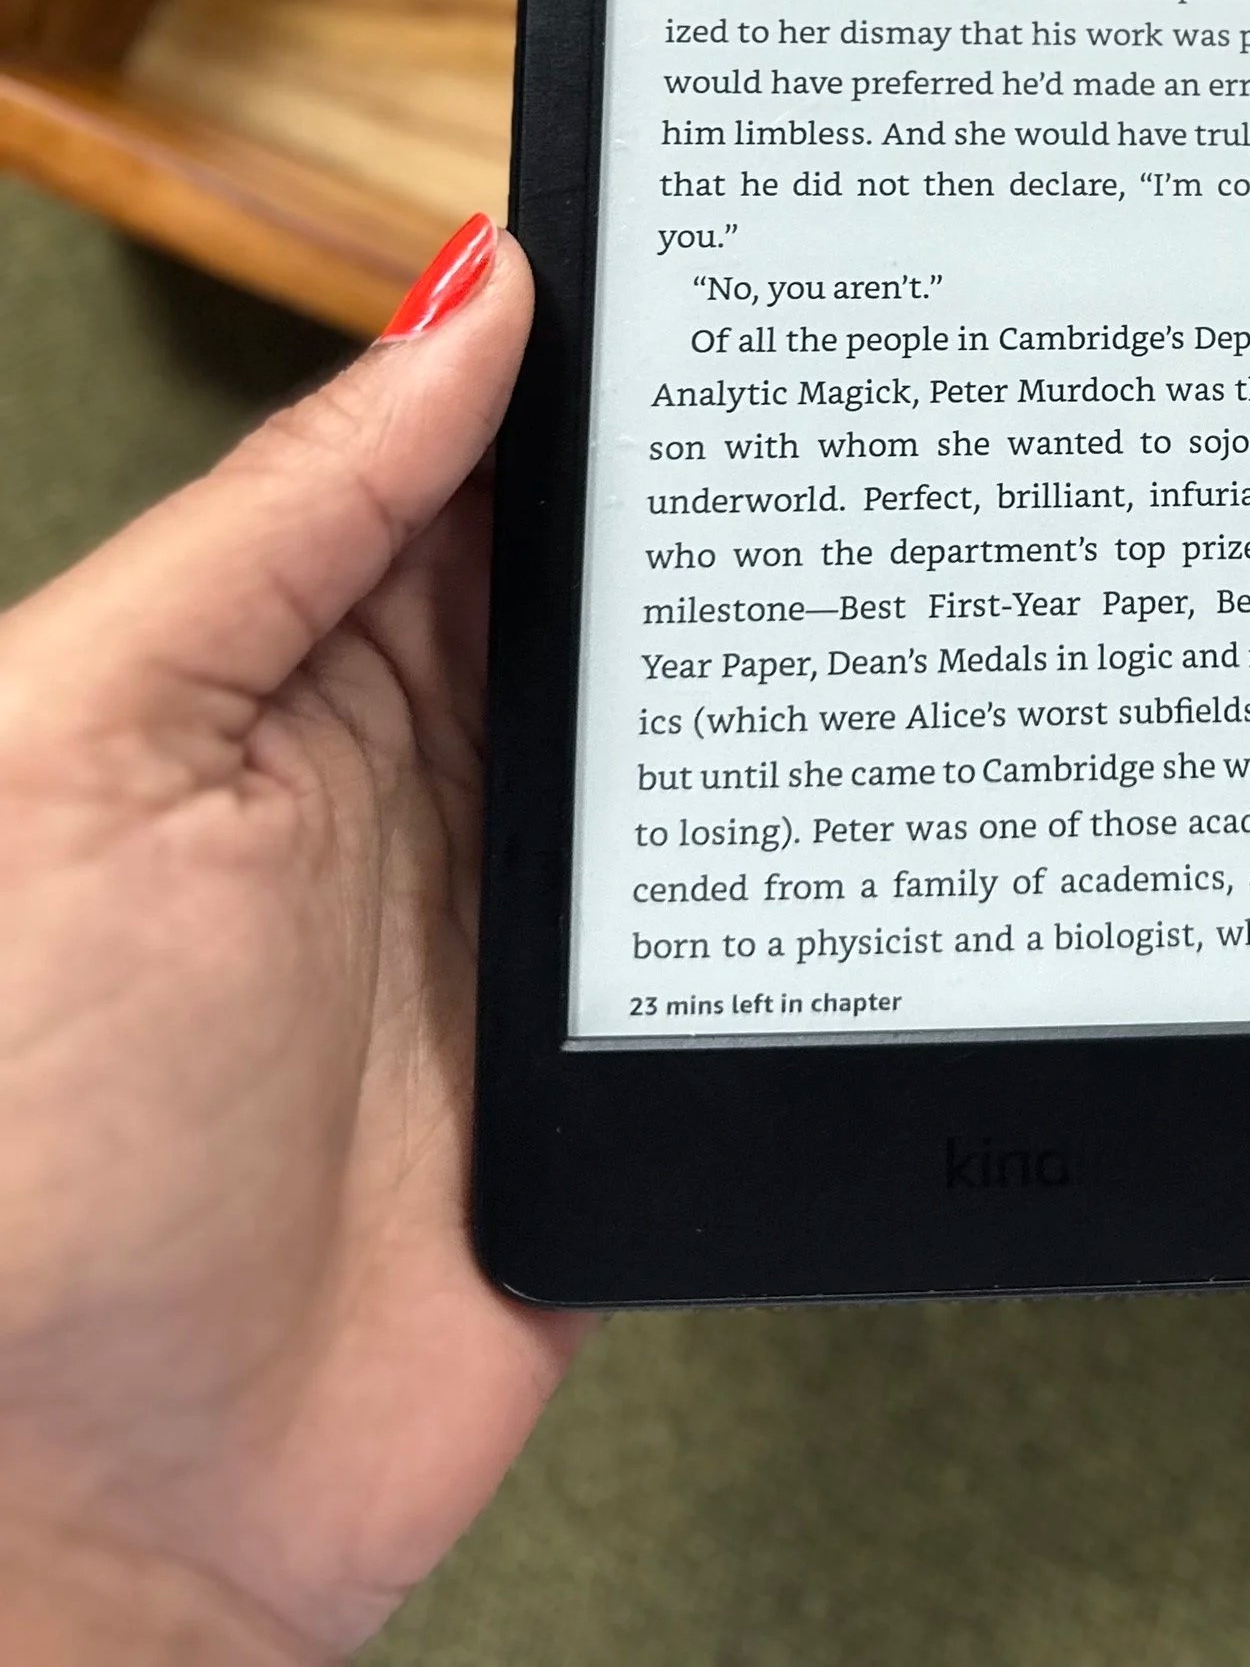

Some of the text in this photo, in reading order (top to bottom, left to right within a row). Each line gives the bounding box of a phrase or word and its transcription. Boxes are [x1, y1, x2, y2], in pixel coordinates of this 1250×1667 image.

[664, 17, 730, 44] ized
[736, 21, 770, 45] to
[777, 17, 832, 45] her
[839, 18, 953, 53] dismay
[959, 19, 1024, 46] that
[1031, 20, 1077, 47] his
[1085, 21, 1164, 47] work
[1171, 28, 1231, 48] was
[662, 68, 764, 95] would
[770, 68, 844, 96] have
[850, 69, 995, 103] preferred
[1001, 69, 1065, 96] he’d
[1072, 70, 1156, 97] made
[1163, 77, 1202, 97] an
[660, 119, 727, 146] him
[733, 118, 873, 146] limbless.
[880, 119, 947, 146] And
[953, 119, 1007, 147] she
[1013, 120, 1111, 147] would
[1116, 120, 1188, 147] have
[658, 170, 727, 198] that
[739, 170, 779, 197] he
[792, 170, 844, 197] did
[856, 174, 911, 197] not
[922, 170, 996, 197] then
[1009, 170, 1126, 203] declare,
[1139, 171, 1204, 197] “I’m
[656, 222, 739, 257] you.”
[692, 273, 943, 309] “No, you aren’t.”
[690, 326, 733, 354] Of
[737, 325, 778, 354] all
[785, 325, 838, 353] the
[845, 324, 950, 360] people
[957, 324, 990, 352] in
[998, 323, 1185, 358] Cambridge’s
[650, 378, 788, 415] Analytic
[796, 377, 920, 413] Magick,
[929, 379, 1009, 405] Peter
[1016, 375, 1157, 404] Murdoch
[1164, 382, 1226, 403] was
[648, 440, 707, 462] son
[723, 431, 801, 461] with
[816, 430, 920, 459] whom
[936, 429, 991, 457] she
[1006, 427, 1125, 457] wanted
[1139, 431, 1172, 455] to
[646, 484, 846, 516] underworld.
[862, 482, 981, 516] Perfect,
[995, 481, 1134, 514] brilliant,
[644, 541, 717, 570] who
[732, 546, 804, 569] won
[819, 538, 874, 567] the
[889, 535, 1098, 573] department’s
[1113, 538, 1166, 569] top
[927, 590, 1082, 620] First-Year
[1102, 590, 1195, 624] Paper,
[640, 653, 713, 681] Year
[721, 652, 818, 686] Paper,
[826, 647, 928, 677] Dean’s
[936, 643, 1048, 674] Medals
[1056, 643, 1089, 672] in
[1096, 641, 1174, 678] logic
[1181, 640, 1241, 670] and
[638, 707, 683, 736] ics
[693, 703, 809, 741] (which
[818, 709, 897, 732] were
[904, 700, 1007, 731] Alice’s
[1016, 701, 1109, 728] worst
[634, 823, 669, 848] to
[678, 815, 801, 854] losing).
[812, 817, 896, 845] Peter
[904, 819, 968, 842] was
[978, 818, 1038, 840] one
[1047, 808, 1084, 839] of
[1089, 808, 1178, 838] those
[632, 872, 750, 904] cended
[763, 872, 846, 902] from
[860, 878, 879, 900] a
[892, 867, 1000, 905] family
[1012, 865, 1049, 896] of
[1060, 863, 1234, 897] academics,
[632, 931, 711, 960] born
[721, 934, 757, 959] to
[767, 936, 786, 958] a
[795, 926, 944, 966] physicist
[954, 923, 1016, 954] and
[1026, 930, 1045, 952] a
[1053, 919, 1204, 957] biologist,
[628, 991, 903, 1018] 23 mins left in chapter
